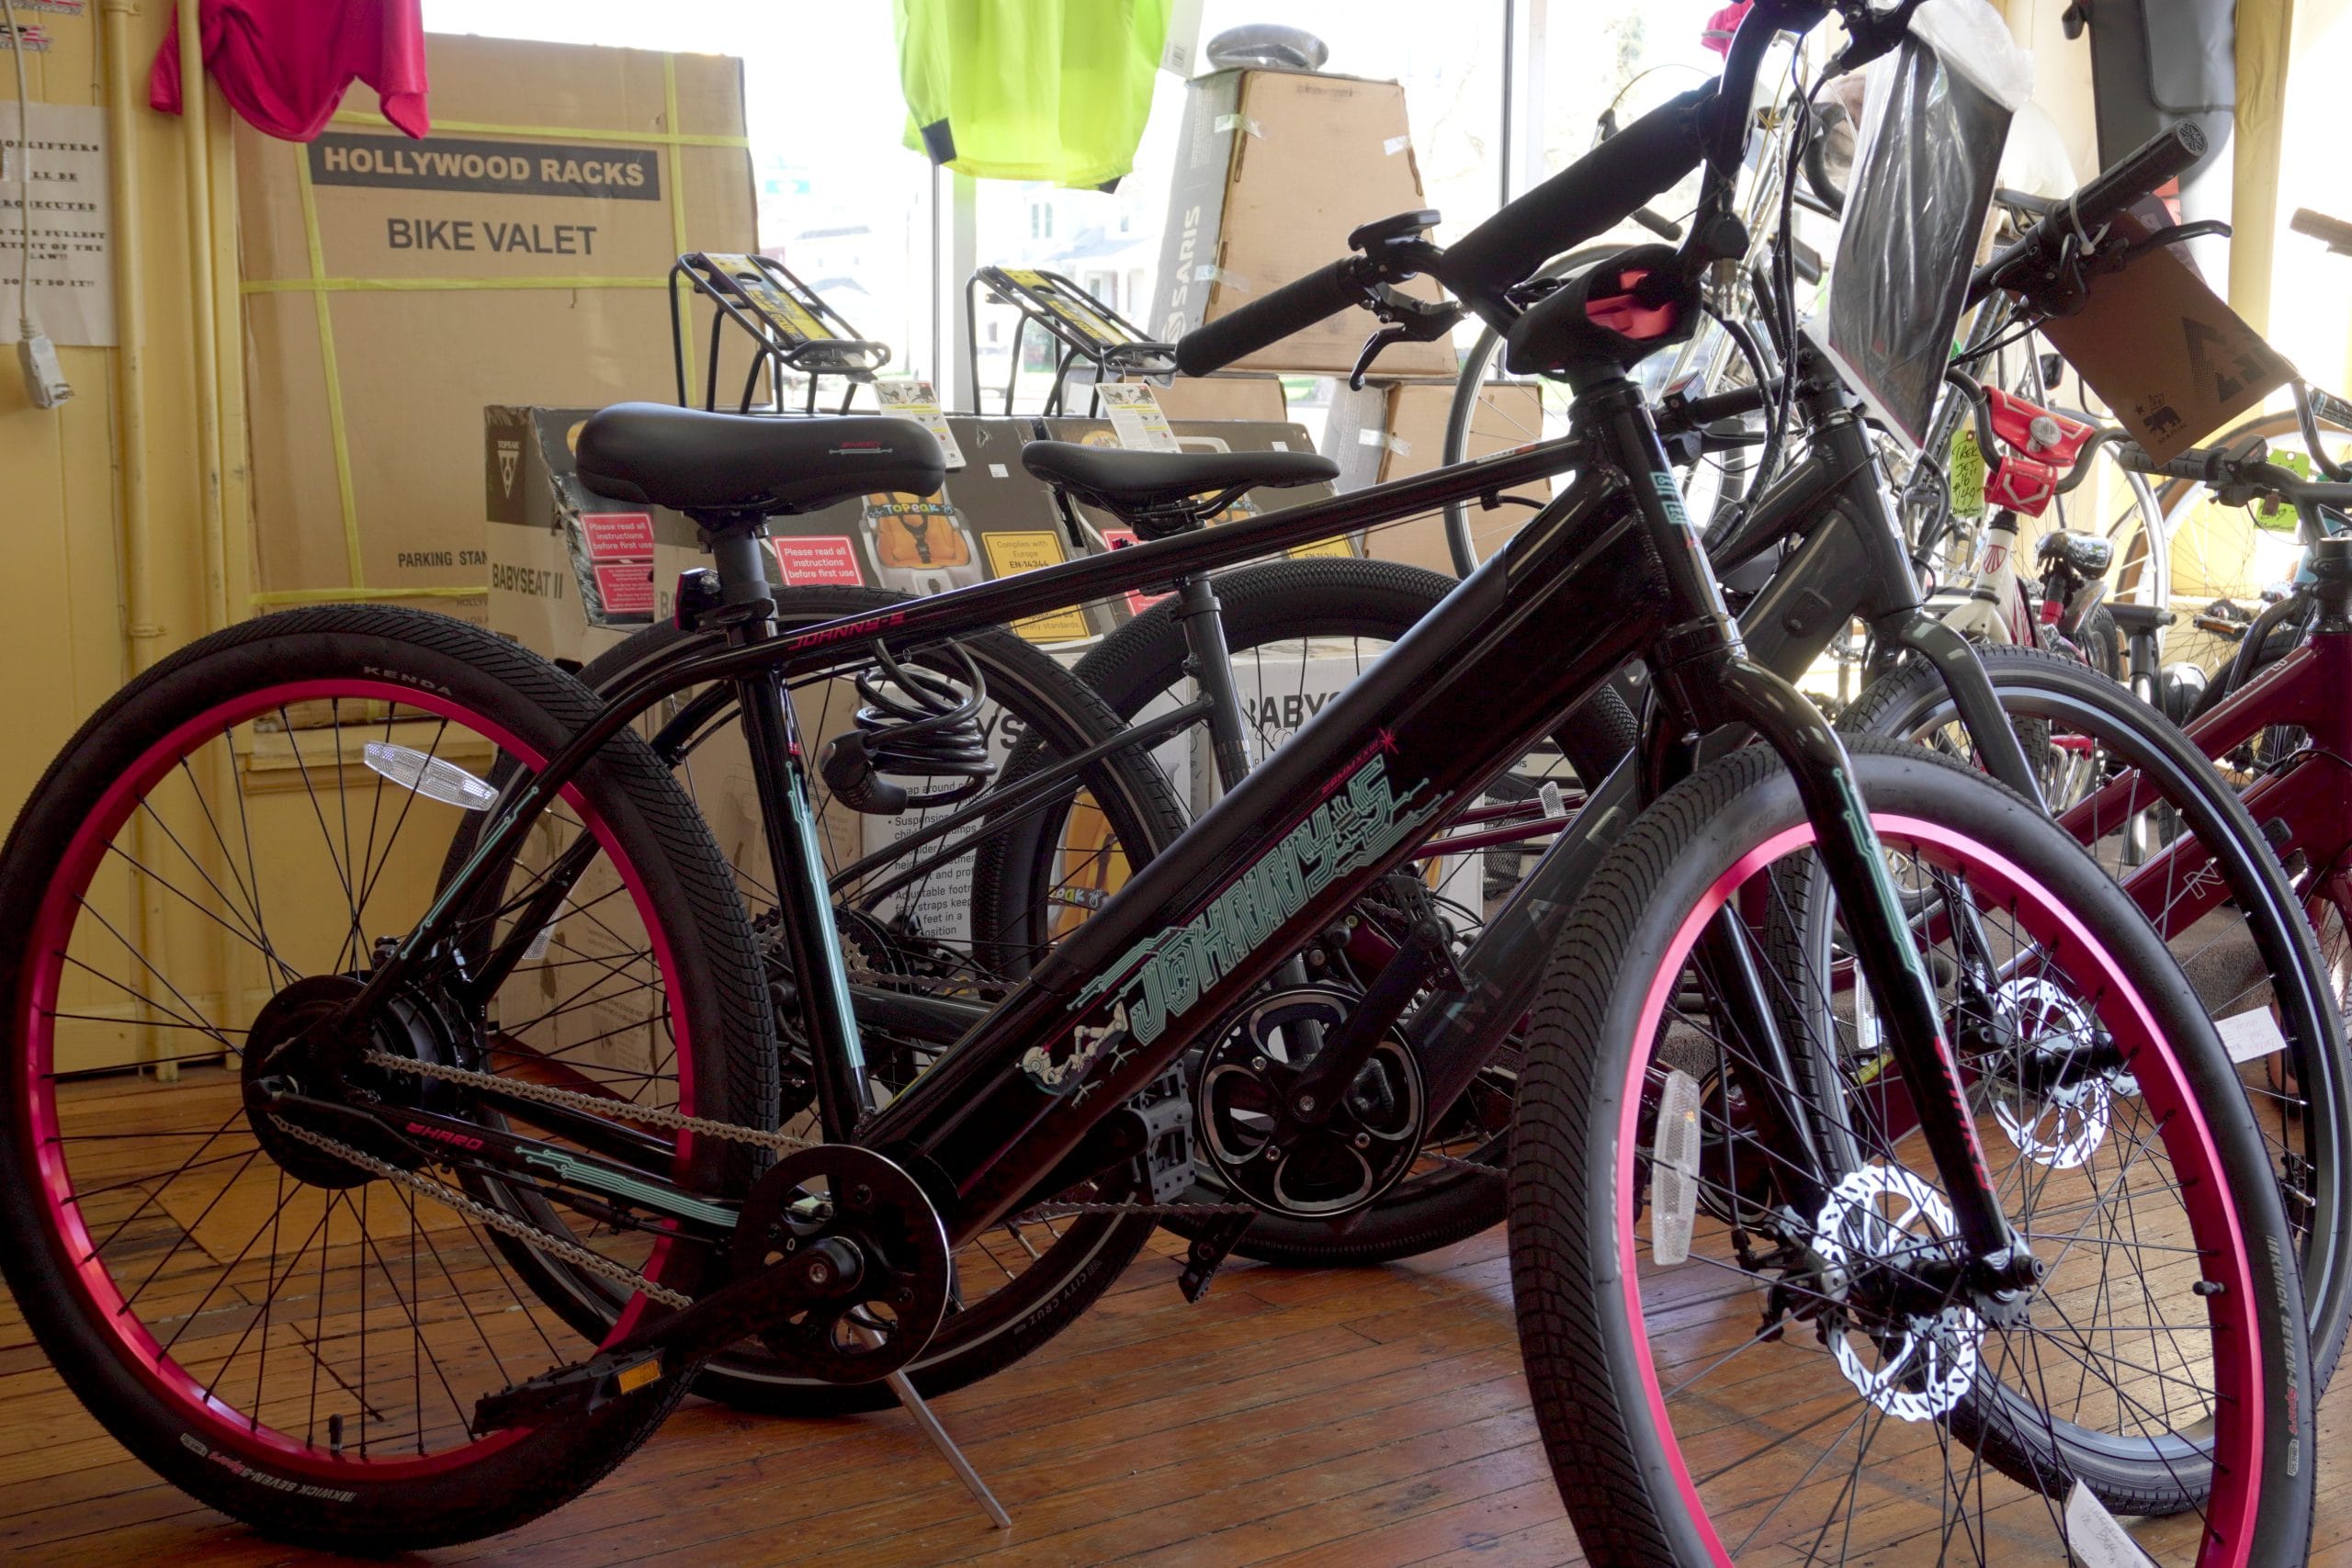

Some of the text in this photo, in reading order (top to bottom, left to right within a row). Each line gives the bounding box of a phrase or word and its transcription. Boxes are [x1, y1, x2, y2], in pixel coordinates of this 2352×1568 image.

[323, 147, 645, 186] HOLLYWOOD RACKS
[45, 231, 106, 240] FULLEST
[387, 219, 597, 254] BIKE VALET
[1171, 205, 1201, 308] SARIS
[497, 441, 519, 449] TOPEAK
[1952, 440, 1979, 460] TREK
[1956, 458, 1979, 477] JET
[996, 539, 1048, 550] Complies with
[784, 547, 846, 556] Please read all
[399, 552, 453, 567] PARKING
[793, 558, 844, 568] instructions
[788, 570, 817, 578] before
[819, 569, 837, 578] first
[492, 563, 563, 599] BABYSEAT II
[363, 666, 452, 696] KENDA
[922, 782, 956, 794] around
[935, 869, 953, 879] and
[919, 901, 948, 912] straps
[923, 914, 943, 923] feet
[946, 911, 954, 920] in
[1029, 1272, 1087, 1326] CITY CRUZ
